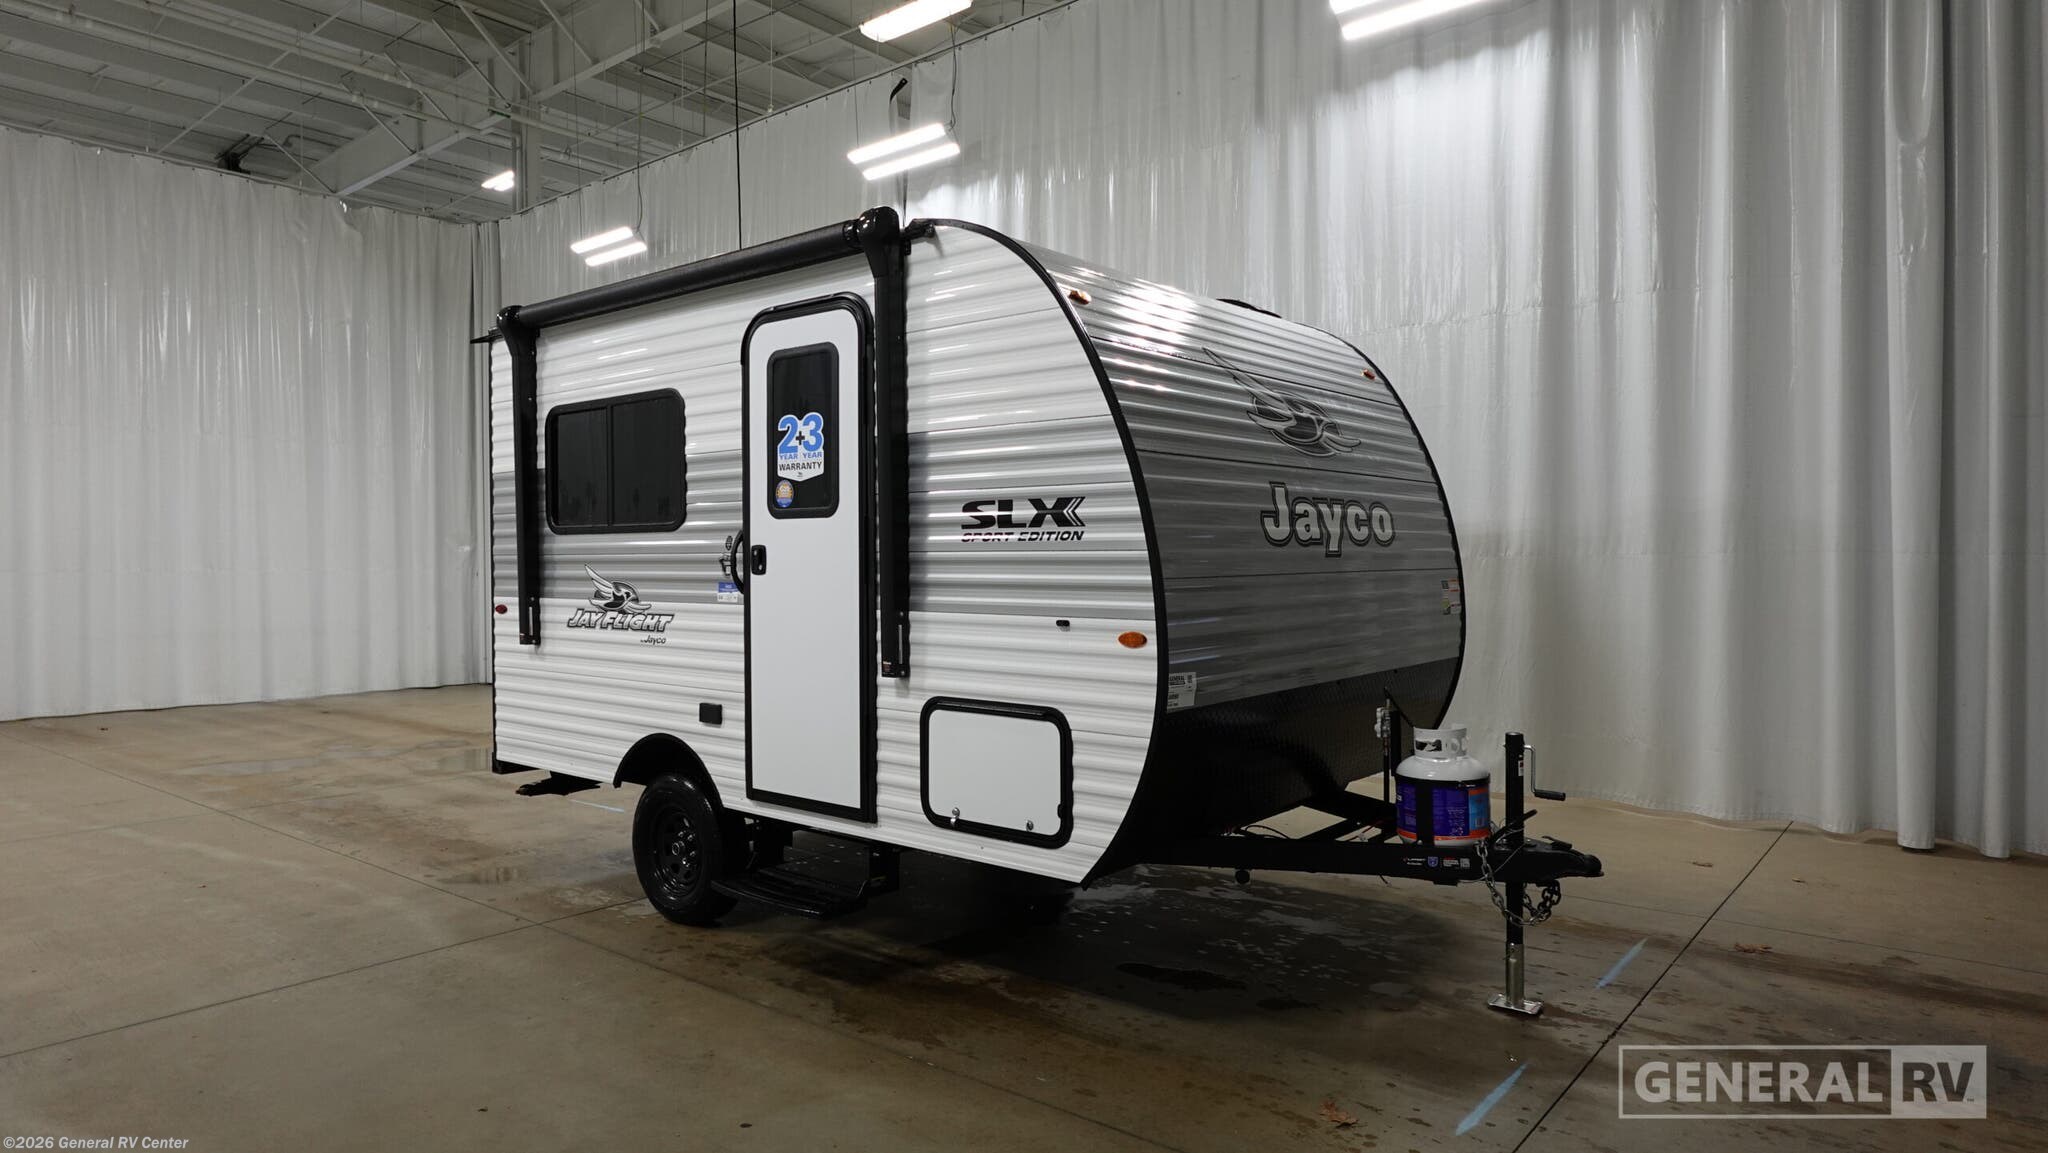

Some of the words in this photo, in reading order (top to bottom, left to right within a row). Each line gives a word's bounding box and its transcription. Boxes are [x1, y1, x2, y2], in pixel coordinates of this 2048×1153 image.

[779, 461, 822, 472] WARRANTY
[961, 496, 1086, 529] SLX
[1260, 481, 1396, 558] Jayco
[1017, 531, 1084, 542] EDITION
[567, 608, 602, 628] JAY
[599, 611, 675, 632] FLIGHT
